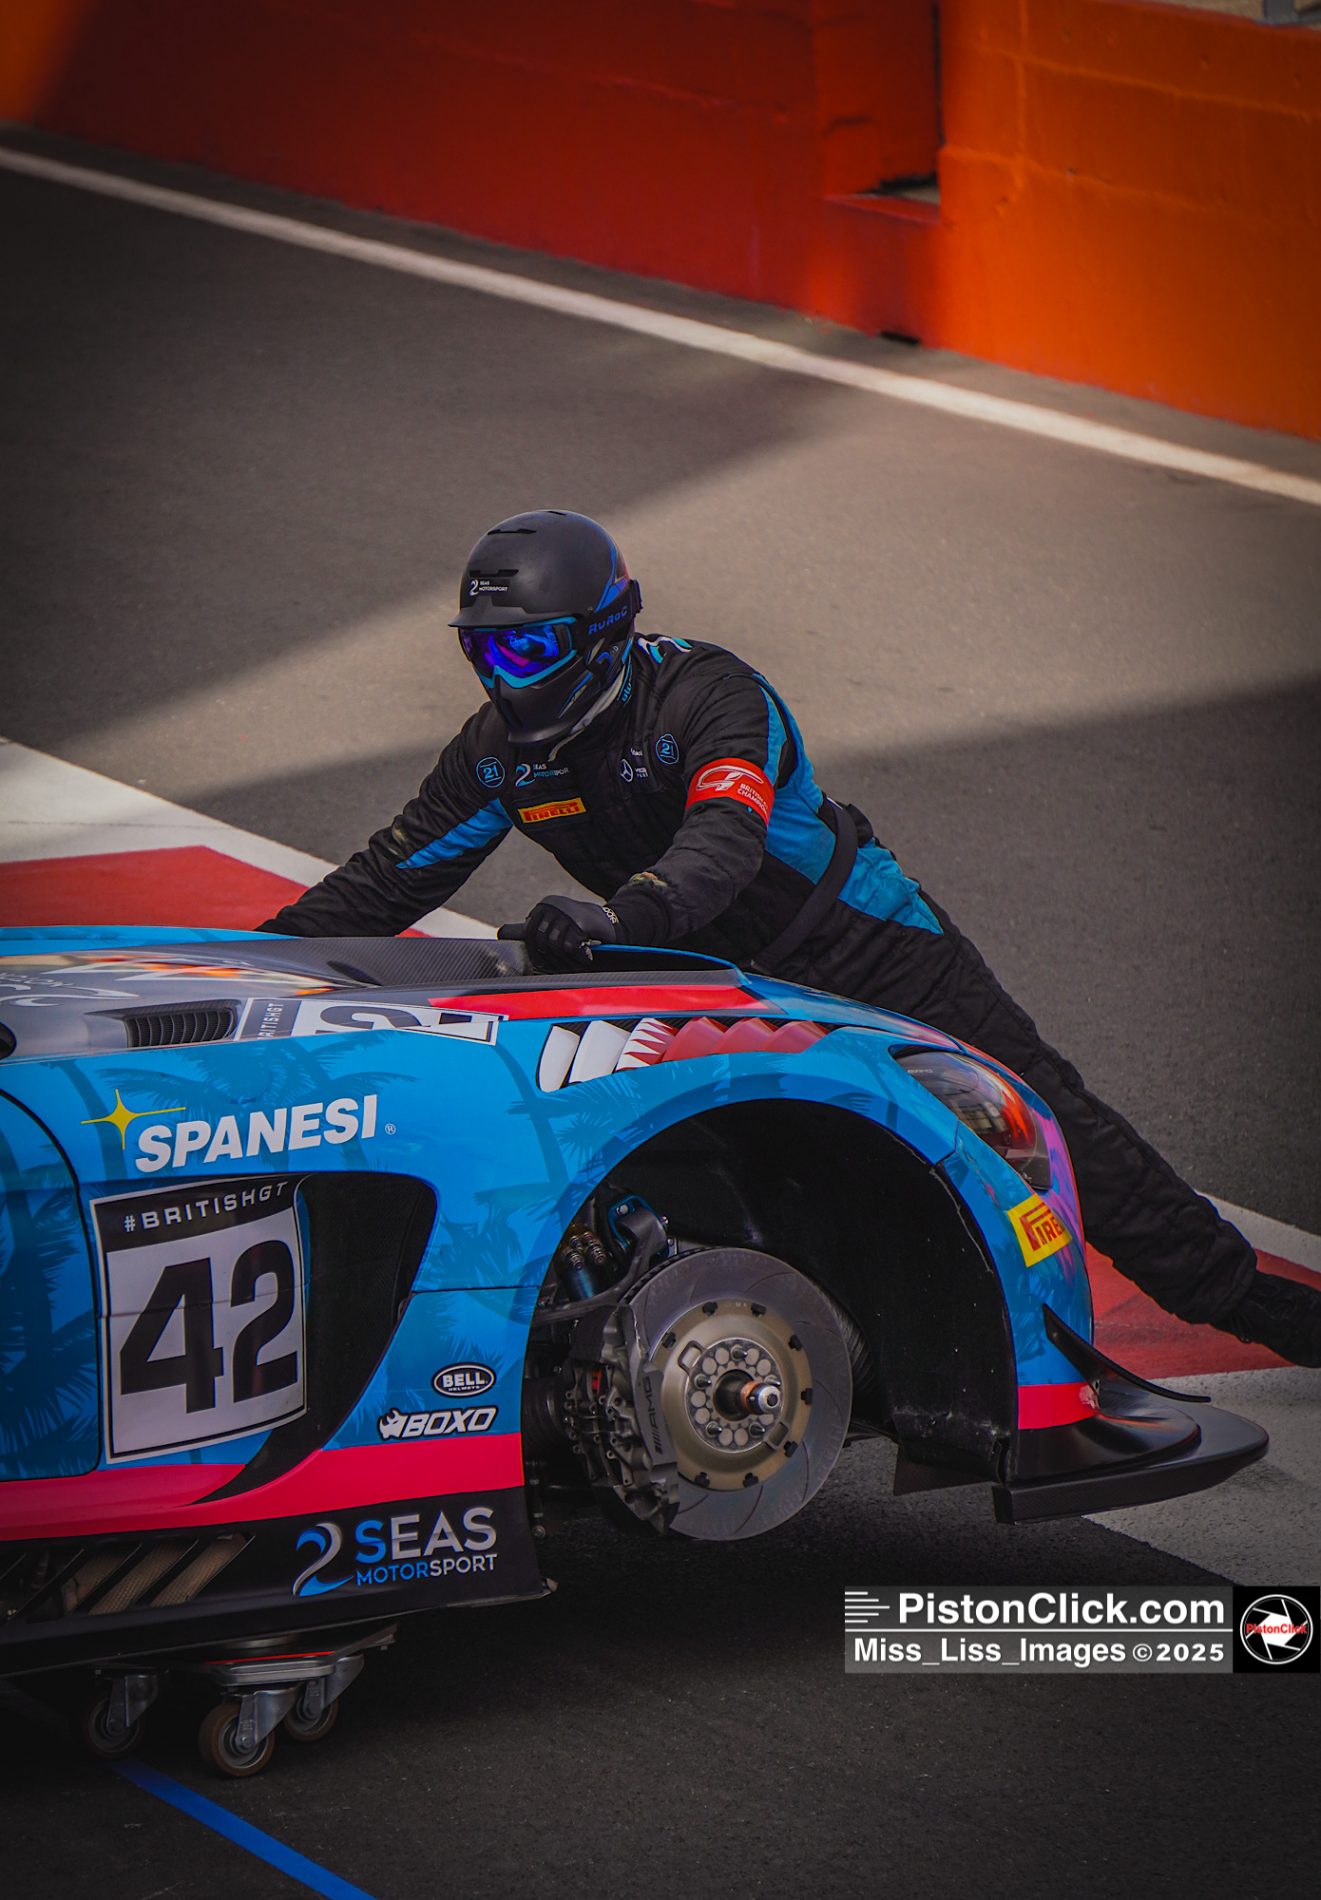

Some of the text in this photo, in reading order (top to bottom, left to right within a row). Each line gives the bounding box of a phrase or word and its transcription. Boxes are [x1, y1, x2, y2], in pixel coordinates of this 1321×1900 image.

[483, 764, 499, 780] 21
[257, 1003, 285, 1040] RITISHGT
[135, 1094, 378, 1173] SPANESI
[124, 1181, 288, 1232] #BRITISHGT
[1019, 1202, 1066, 1251] PIRE
[119, 1239, 298, 1414] 42
[442, 1371, 485, 1388] BELL
[401, 1407, 497, 1438] BOXO
[293, 1506, 497, 1597] 2 SEAS
[355, 1553, 498, 1586] MOTORSPORT
